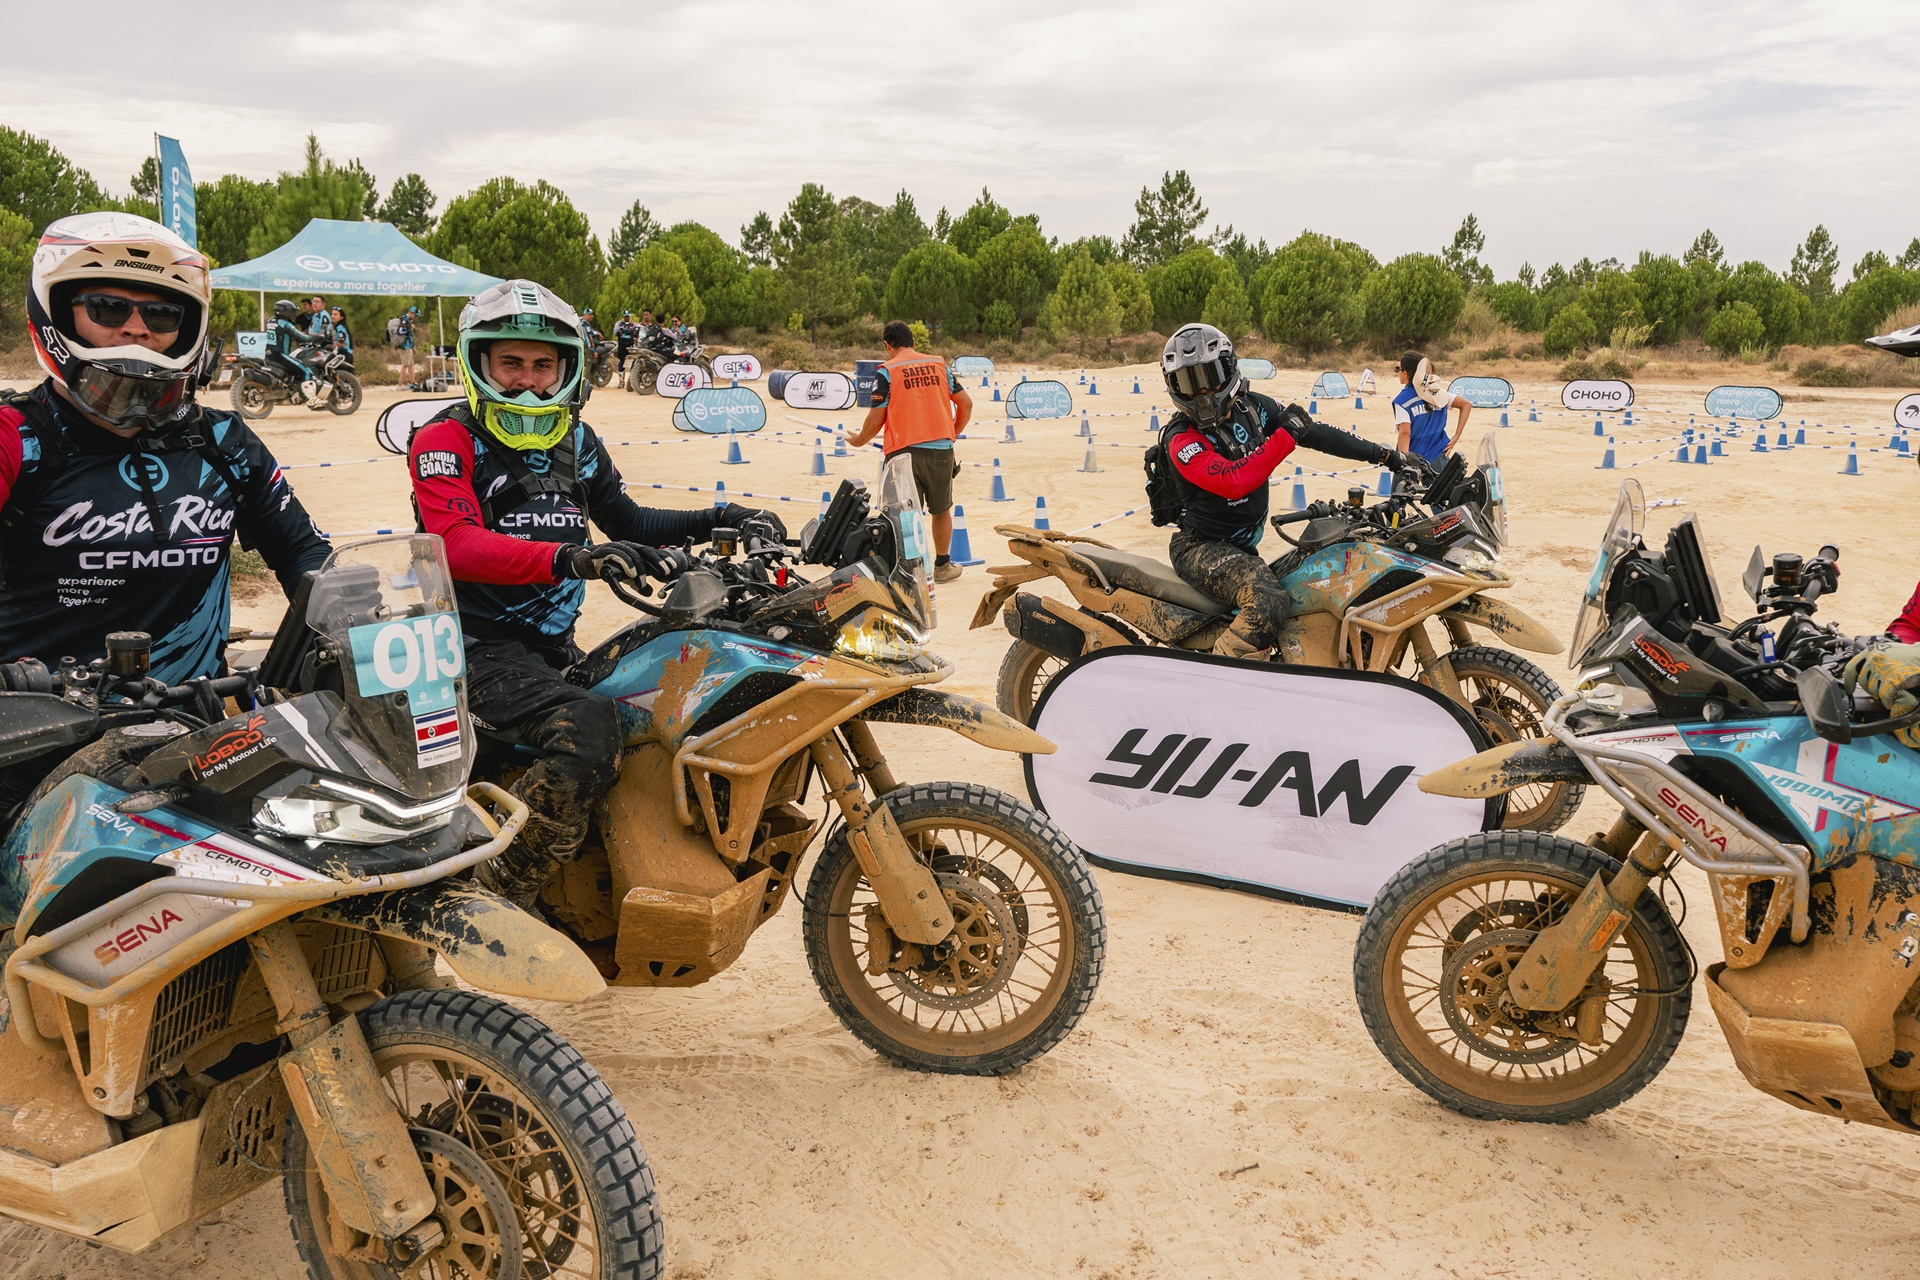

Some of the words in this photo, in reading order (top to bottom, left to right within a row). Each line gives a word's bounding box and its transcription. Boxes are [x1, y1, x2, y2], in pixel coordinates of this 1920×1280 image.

[113, 259, 165, 274] ANSWER
[338, 260, 457, 274] CFMOTO
[274, 277, 341, 291] experience
[344, 281, 373, 292] more
[376, 279, 427, 294] together
[241, 336, 256, 345] C6
[723, 362, 741, 373] elf
[902, 365, 936, 378] SAFETY
[666, 373, 685, 387] elf
[810, 381, 825, 391] MT
[904, 376, 940, 390] OFFICER
[1021, 385, 1060, 394] experience
[1465, 388, 1505, 397] CFMOTO
[1570, 389, 1622, 401] CHOHO
[1717, 389, 1769, 398] experience
[176, 405, 189, 419] FOX
[709, 405, 759, 415] CFMOTO
[1026, 405, 1058, 416] together
[1714, 406, 1755, 416] together
[1177, 442, 1199, 459] CLAUDIA
[419, 452, 457, 464] CLAUDIA
[42, 499, 154, 548] Costa
[168, 494, 234, 541] Rica
[499, 513, 585, 528] CFMOTO
[1432, 514, 1461, 535] LOBOO
[79, 546, 219, 570] CFMOTO
[57, 576, 126, 589] experience
[57, 586, 90, 596] more
[58, 594, 108, 607] together
[816, 609, 828, 617] For
[373, 614, 463, 689] 013
[722, 641, 769, 660] SENA
[1634, 632, 1679, 675] LOBOO
[1629, 640, 1639, 651] For
[1637, 648, 1648, 659] My
[1646, 656, 1668, 676] Motour
[1667, 673, 1680, 685] Life
[1617, 736, 1667, 746] CFMOTO
[1718, 730, 1782, 743] SENA
[194, 729, 264, 771] LOBOO
[201, 768, 214, 779] For
[214, 762, 228, 773] My
[227, 745, 259, 766] Motour
[258, 736, 278, 750] Life
[1088, 728, 1417, 826] YU-AN
[85, 803, 136, 838] SENA
[1657, 787, 1727, 853] SENA
[204, 850, 273, 877] CFMOTO
[94, 909, 184, 968] SENA
